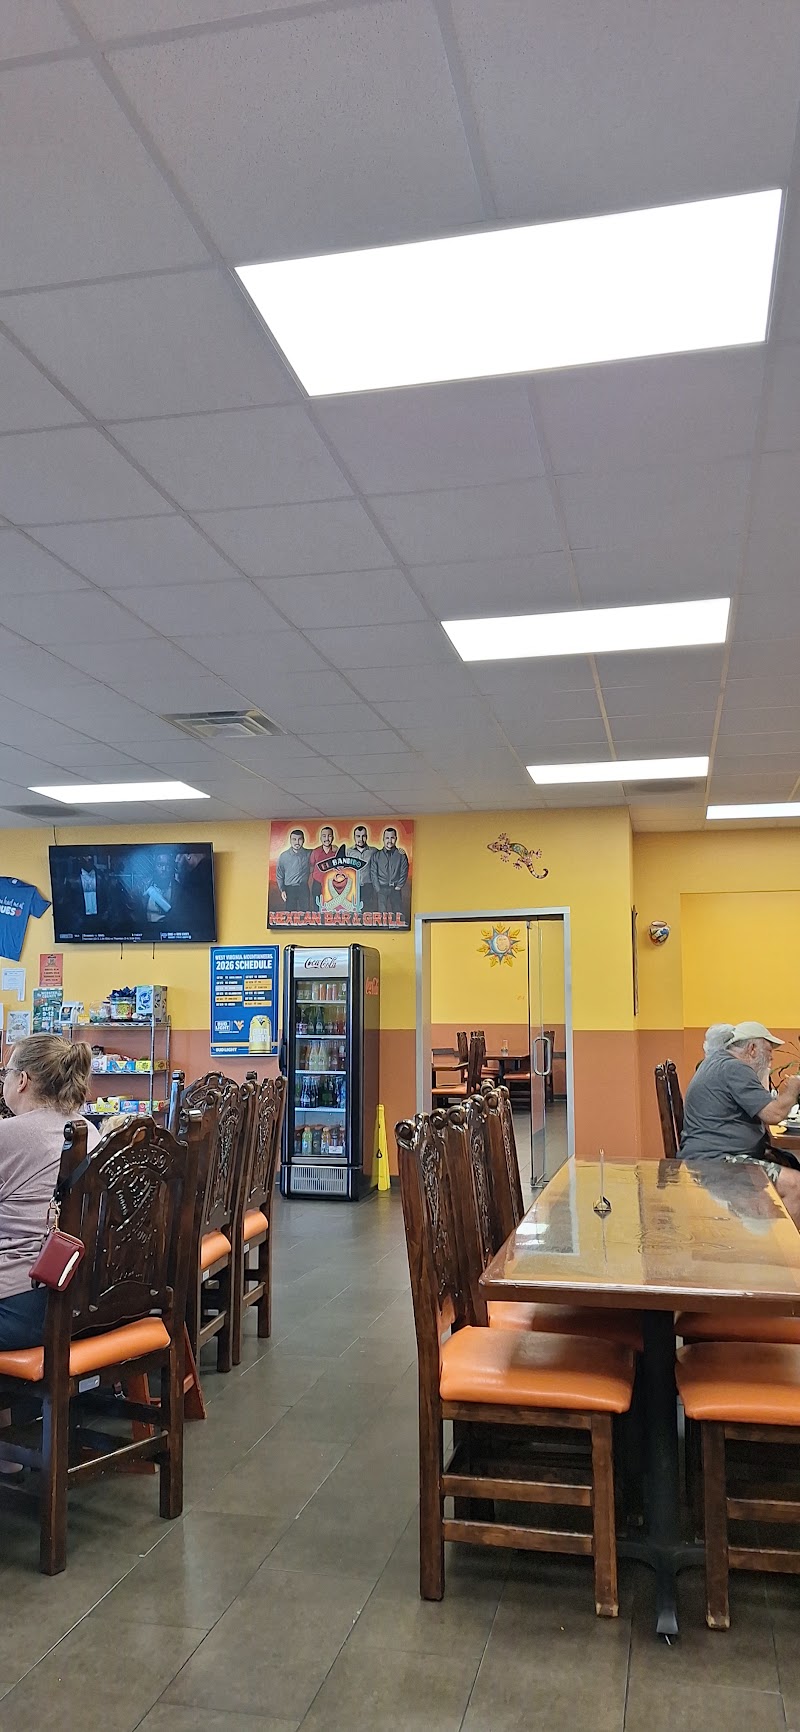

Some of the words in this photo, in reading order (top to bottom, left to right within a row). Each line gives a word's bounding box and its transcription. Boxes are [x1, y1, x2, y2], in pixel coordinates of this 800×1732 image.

[331, 857, 362, 868] BANDIDO
[269, 911, 321, 926] MEXICAN
[323, 912, 352, 926] BAR
[353, 913, 361, 926] &
[362, 912, 407, 927] GRILL
[216, 960, 234, 970] 2026
[235, 960, 272, 969] SCHEDULE
